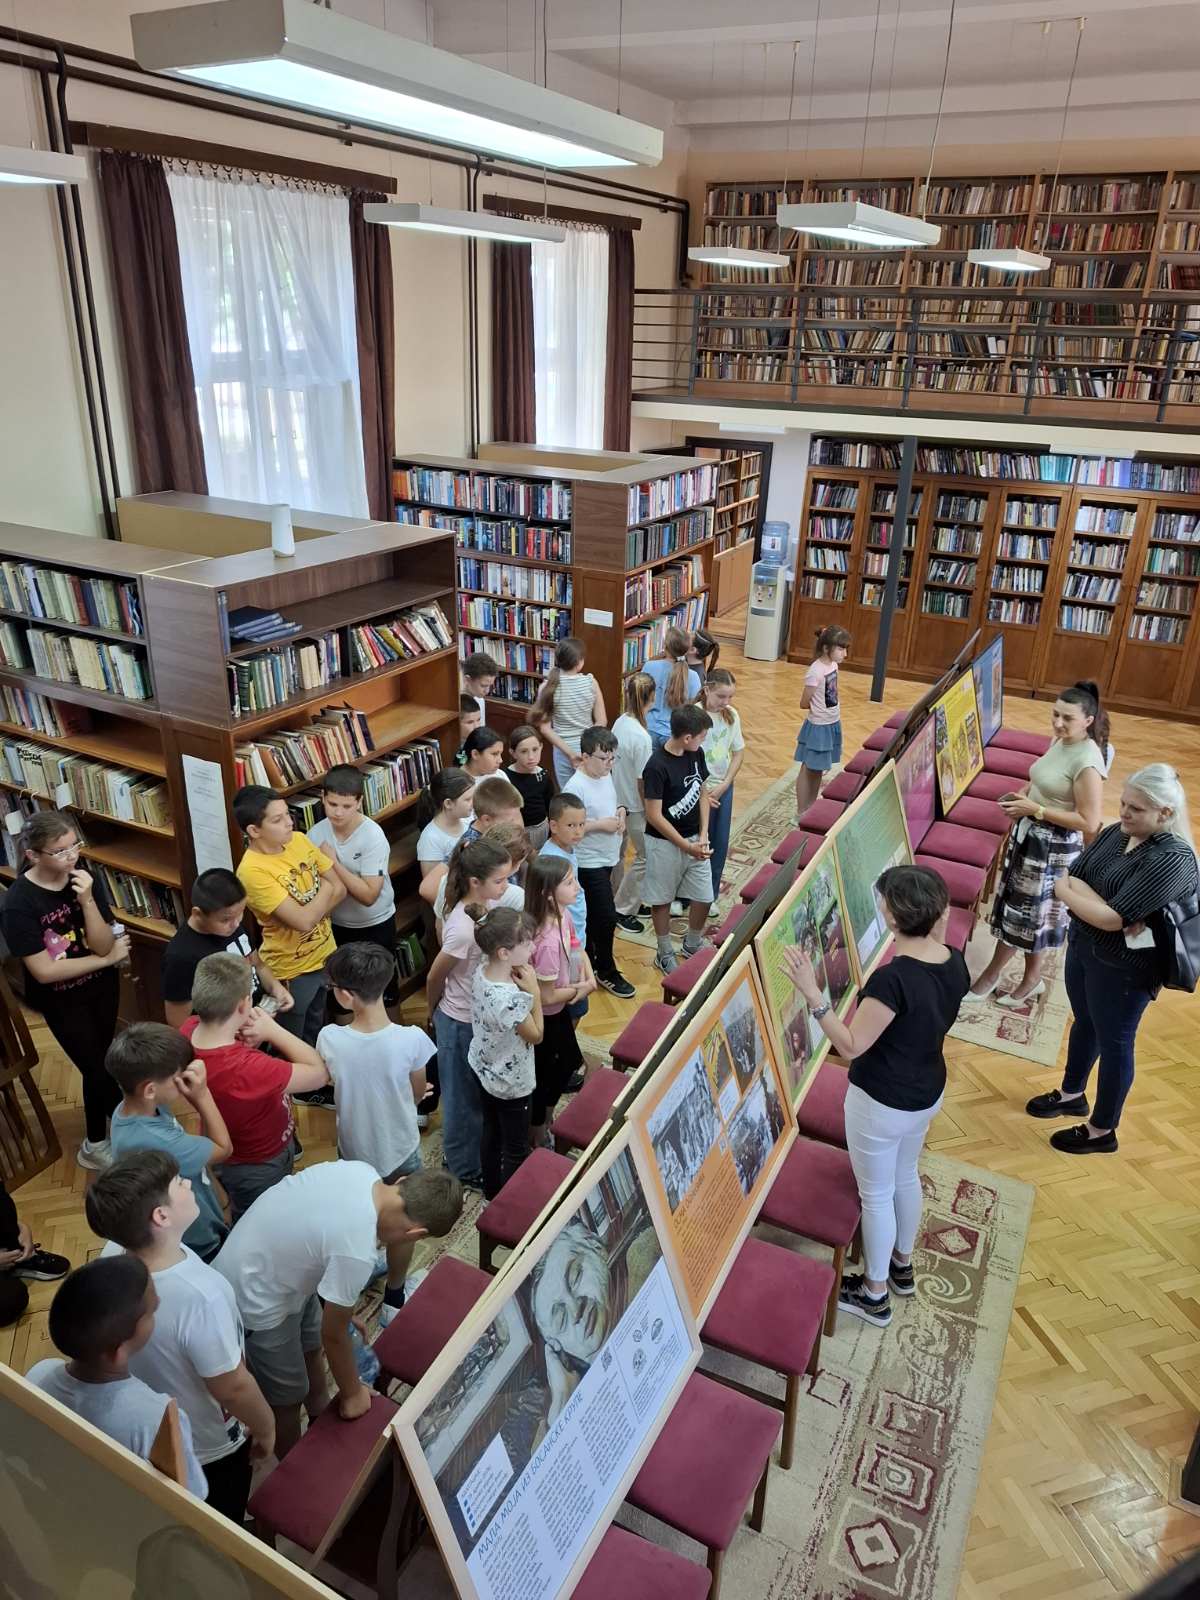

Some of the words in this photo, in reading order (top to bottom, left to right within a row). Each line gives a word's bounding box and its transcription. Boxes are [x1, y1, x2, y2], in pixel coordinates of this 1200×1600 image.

[477, 1521, 502, 1560] МАЛА
[500, 1490, 522, 1521] МОЈА
[521, 1473, 532, 1492] ИЗ
[530, 1421, 566, 1474] БОСАНСКЕ
